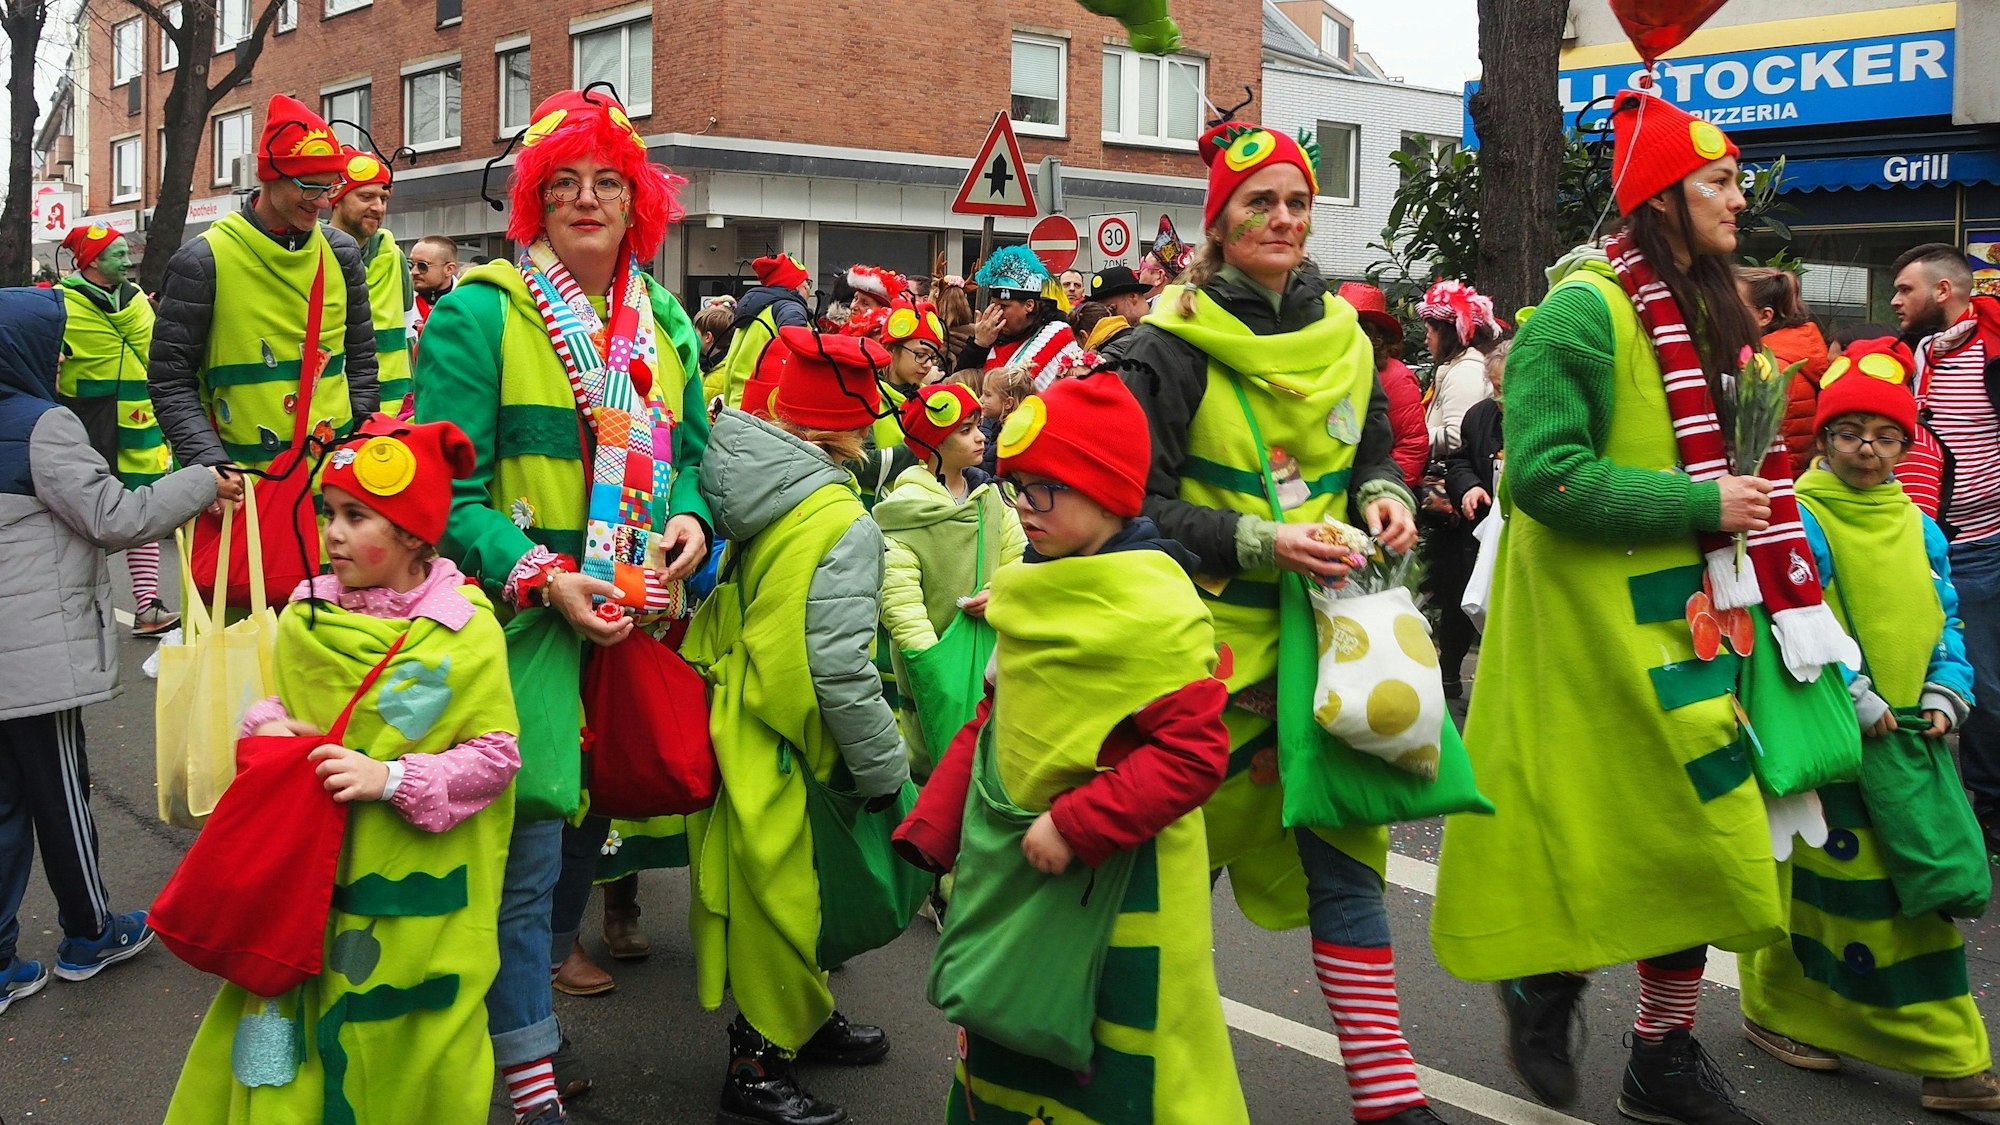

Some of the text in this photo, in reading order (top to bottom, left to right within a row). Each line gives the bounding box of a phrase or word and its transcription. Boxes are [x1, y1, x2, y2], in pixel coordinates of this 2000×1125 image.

[1559, 39, 1947, 112] LLSTOCKER
[1883, 153, 1949, 183] Grill
[189, 203, 218, 219] Apotheke
[1104, 228, 1123, 246] 30
[1103, 258, 1128, 269] ZONE
